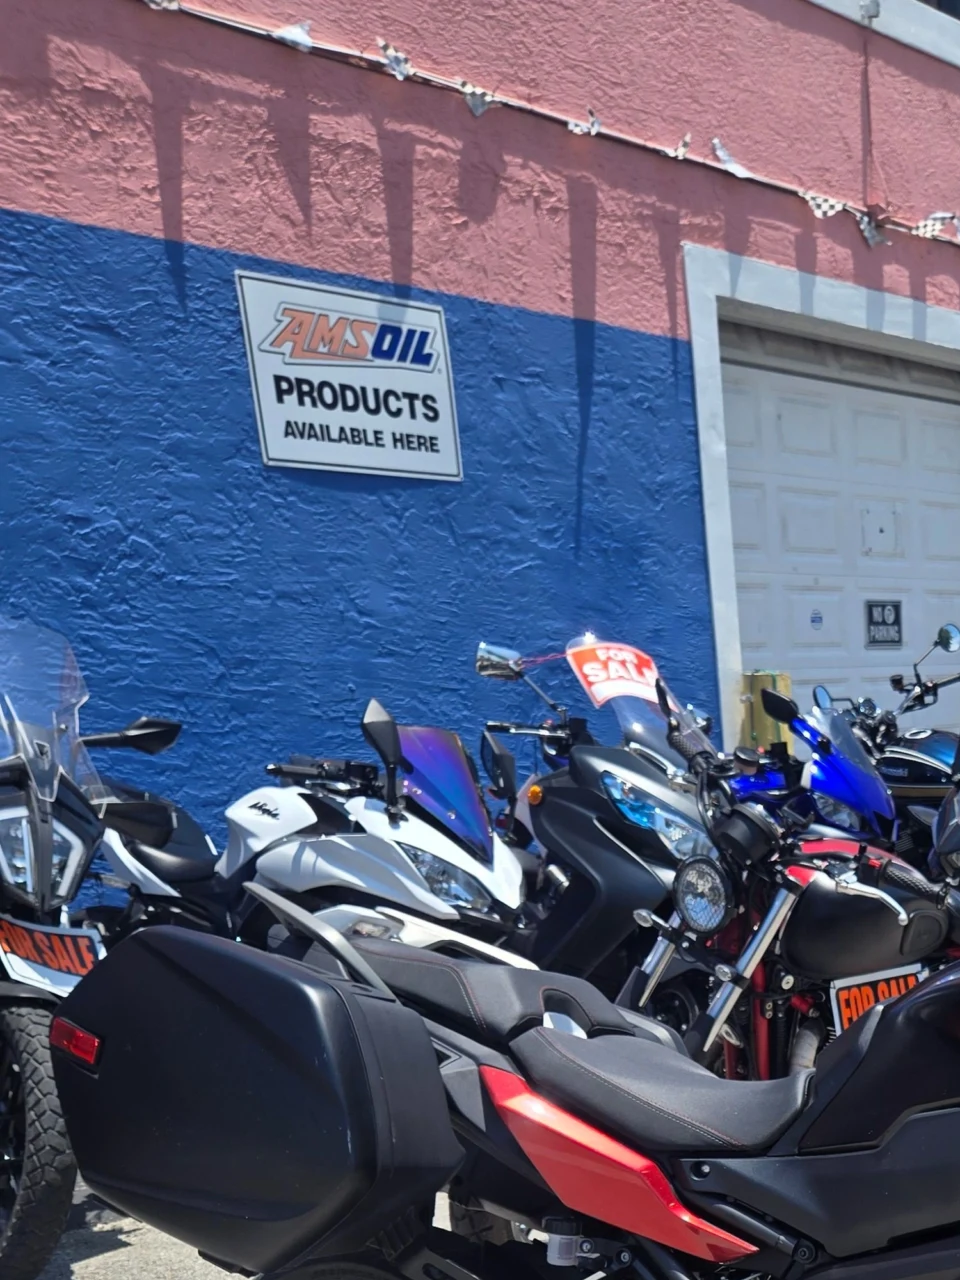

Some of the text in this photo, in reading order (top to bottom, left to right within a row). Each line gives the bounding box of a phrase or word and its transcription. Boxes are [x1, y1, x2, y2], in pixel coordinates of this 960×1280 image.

[269, 307, 434, 367] AMSOIL
[273, 374, 440, 422] PRODUCTS
[284, 420, 441, 453] AVAILABLE HERE
[872, 606, 883, 622] NO
[869, 625, 899, 641] PARKING
[595, 648, 638, 665] FOR
[33, 932, 95, 977] SALE
